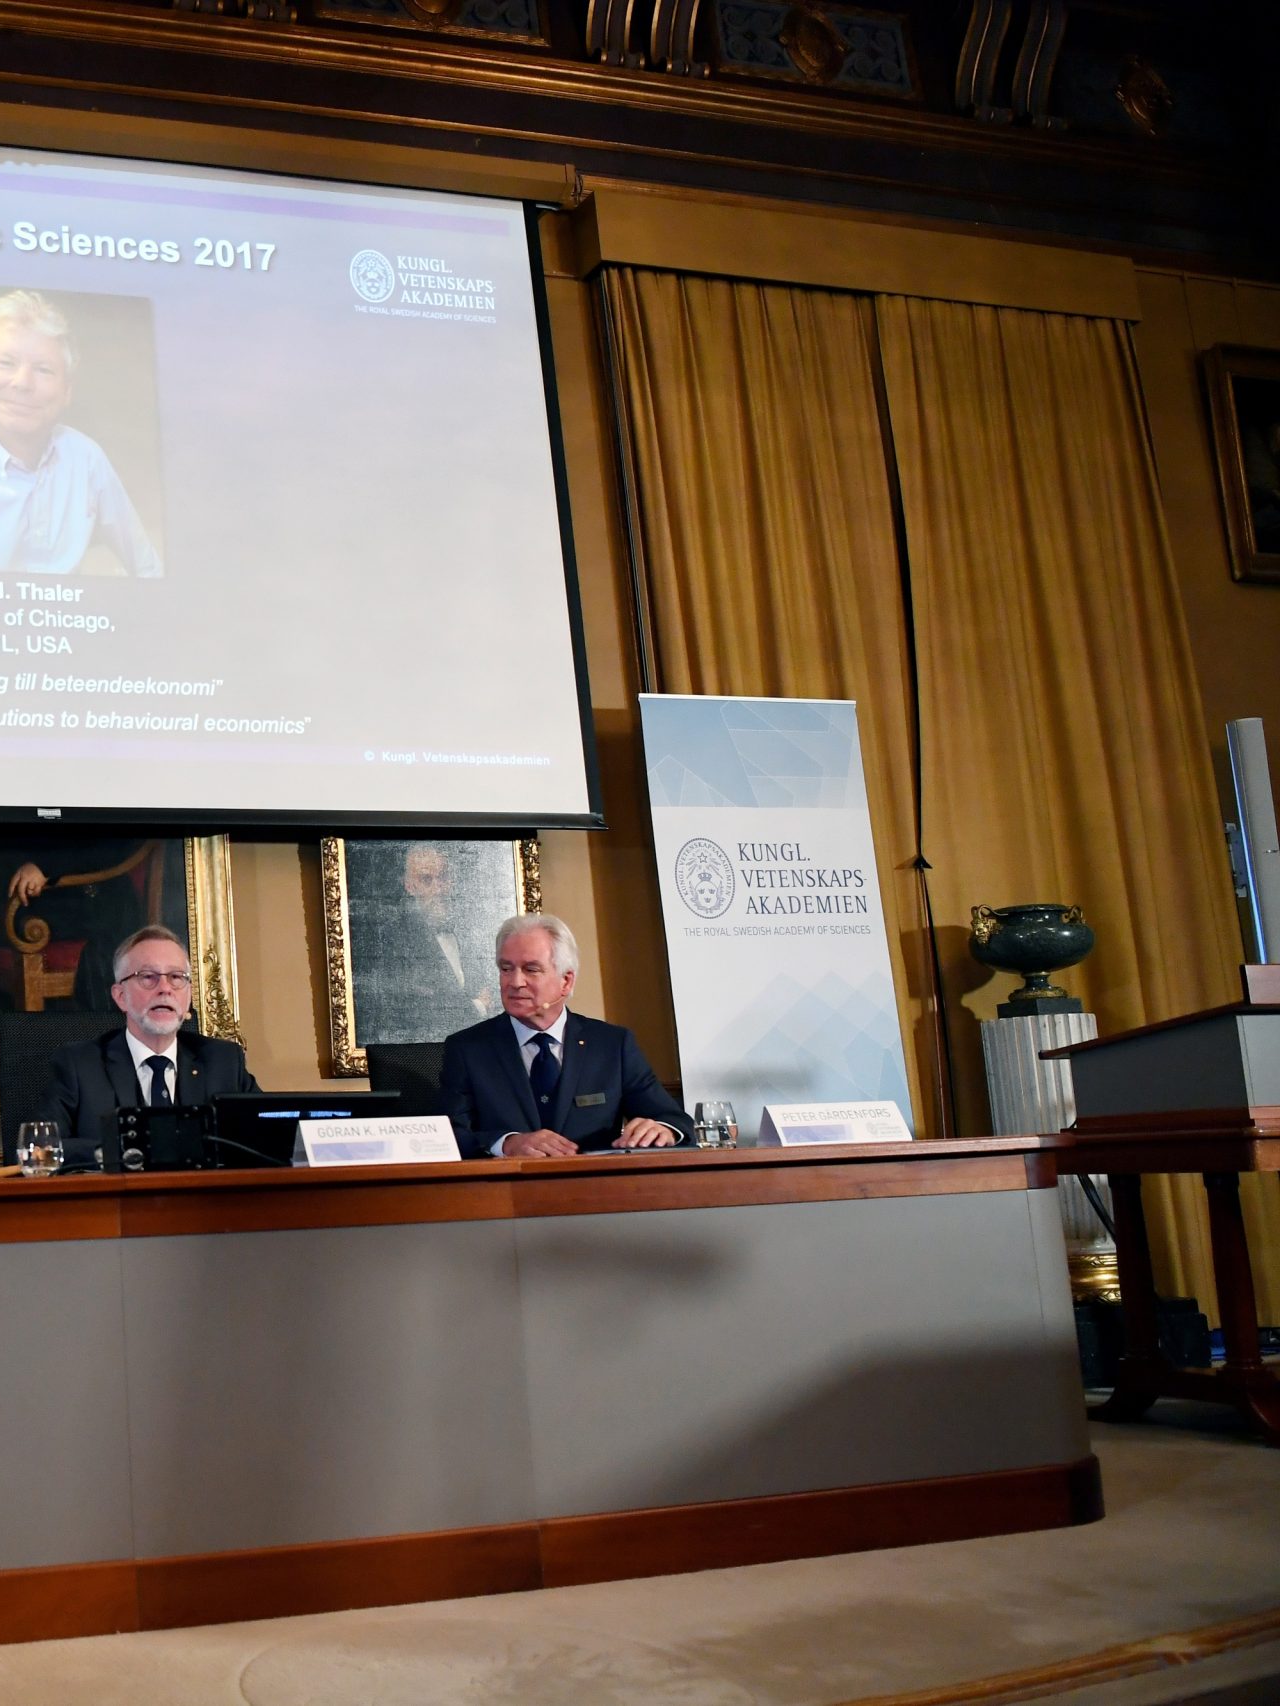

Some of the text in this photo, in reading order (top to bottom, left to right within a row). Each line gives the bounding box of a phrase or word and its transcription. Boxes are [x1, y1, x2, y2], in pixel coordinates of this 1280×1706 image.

[13, 221, 181, 264] Sciences
[193, 237, 276, 271] 2017
[396, 255, 453, 273] KUNGL.
[400, 290, 496, 310] AKADEMIEN
[354, 304, 497, 324] THE ROYAL SWEDISH ACADEMY OF SCIENCES
[16, 582, 84, 602] Thaler
[4, 608, 25, 627] of
[28, 609, 115, 634] Chicago,
[26, 635, 73, 655] USA
[14, 672, 37, 691] till
[60, 711, 79, 729] to
[85, 711, 199, 732] behavioural
[423, 751, 551, 767] Vetenskapsakademien
[737, 842, 811, 862] KUNGL.
[740, 869, 868, 888] VETENSKAPS-
[746, 895, 868, 915] AKADEMIEN
[684, 925, 871, 937] THE ROYAL SWEDISH ACADEMY OF SCIENCES
[782, 1111, 819, 1122] PETER
[379, 1123, 438, 1136] HANSSON
